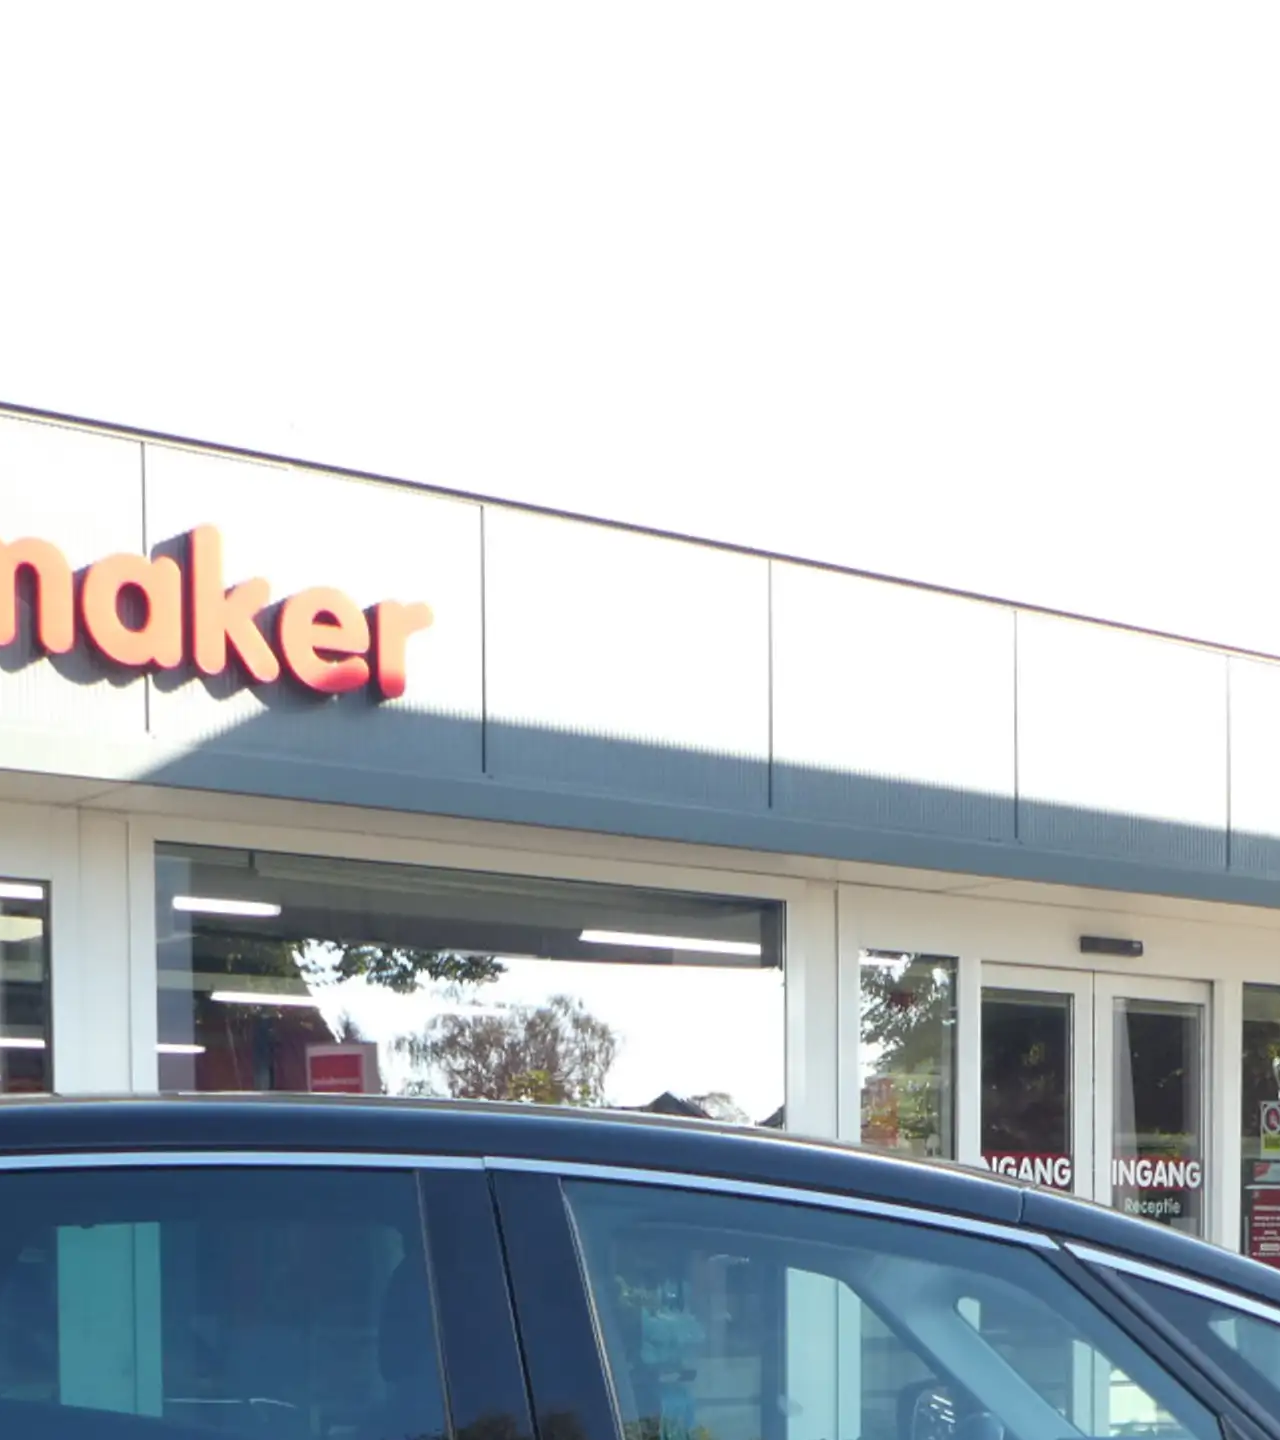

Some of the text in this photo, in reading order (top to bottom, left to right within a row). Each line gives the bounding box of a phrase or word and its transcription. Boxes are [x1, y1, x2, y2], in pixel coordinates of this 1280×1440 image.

[980, 1156, 1071, 1186] NGANG
[1112, 1159, 1202, 1189] INGANG
[1124, 1197, 1181, 1218] Receptie
